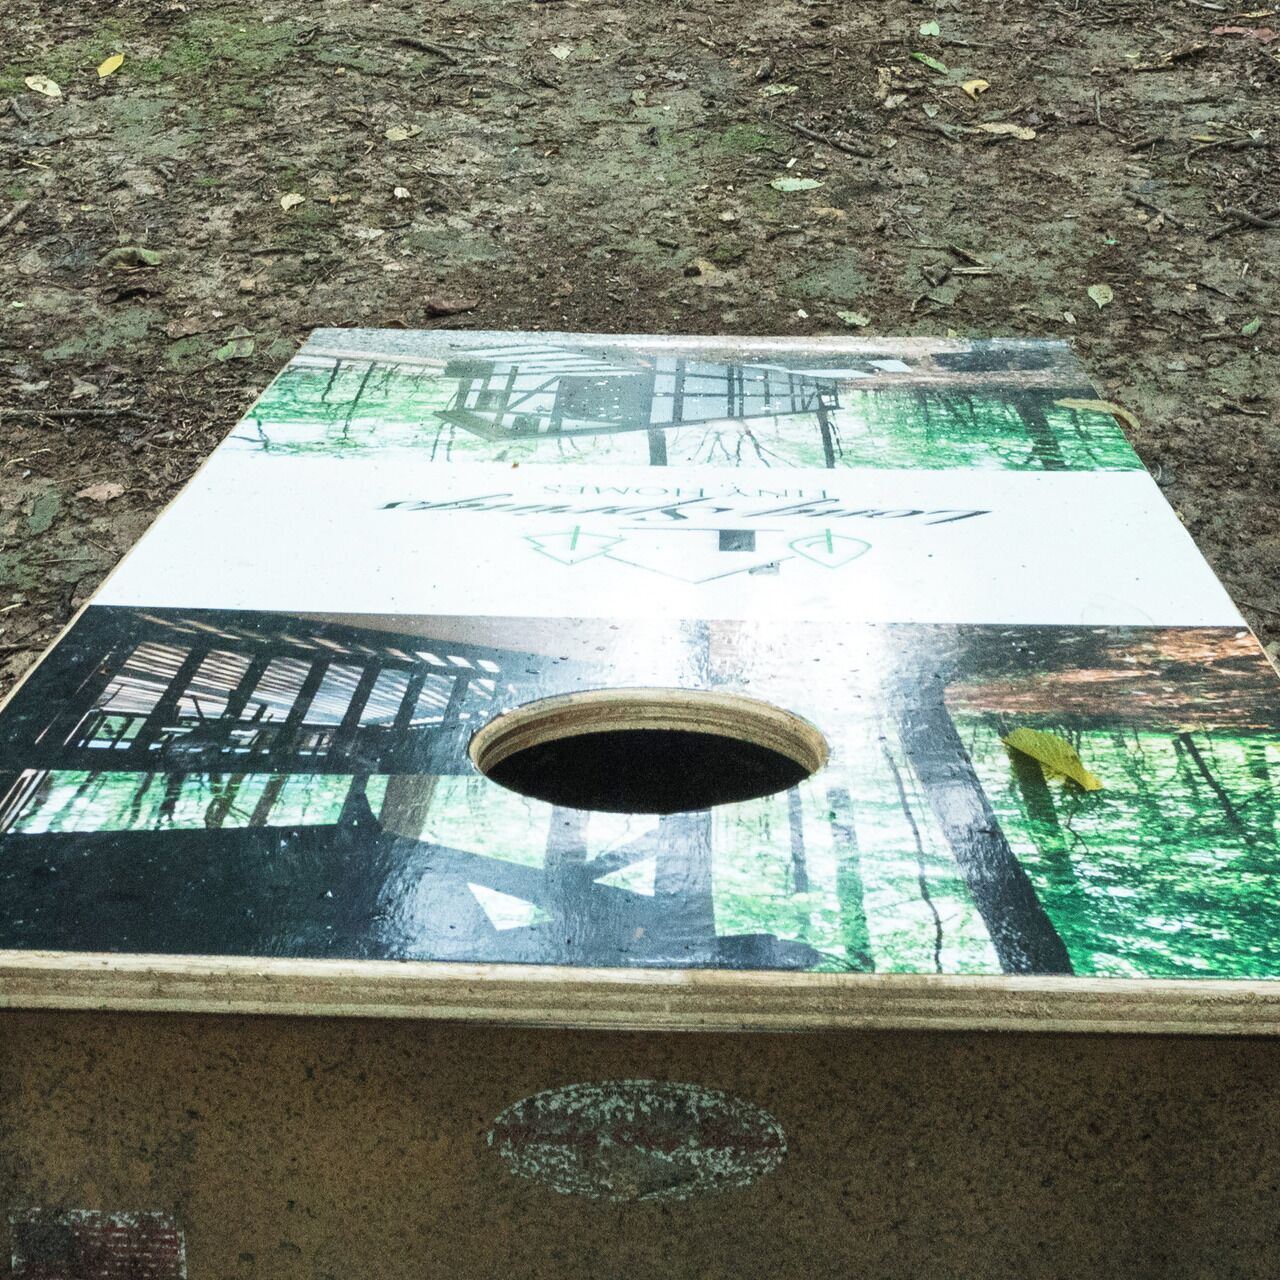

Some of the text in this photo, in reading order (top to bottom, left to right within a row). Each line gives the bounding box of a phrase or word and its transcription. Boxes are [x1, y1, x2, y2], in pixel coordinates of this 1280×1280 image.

[543, 483, 827, 499] TINY HOMES
[376, 493, 993, 525] Long Springs
